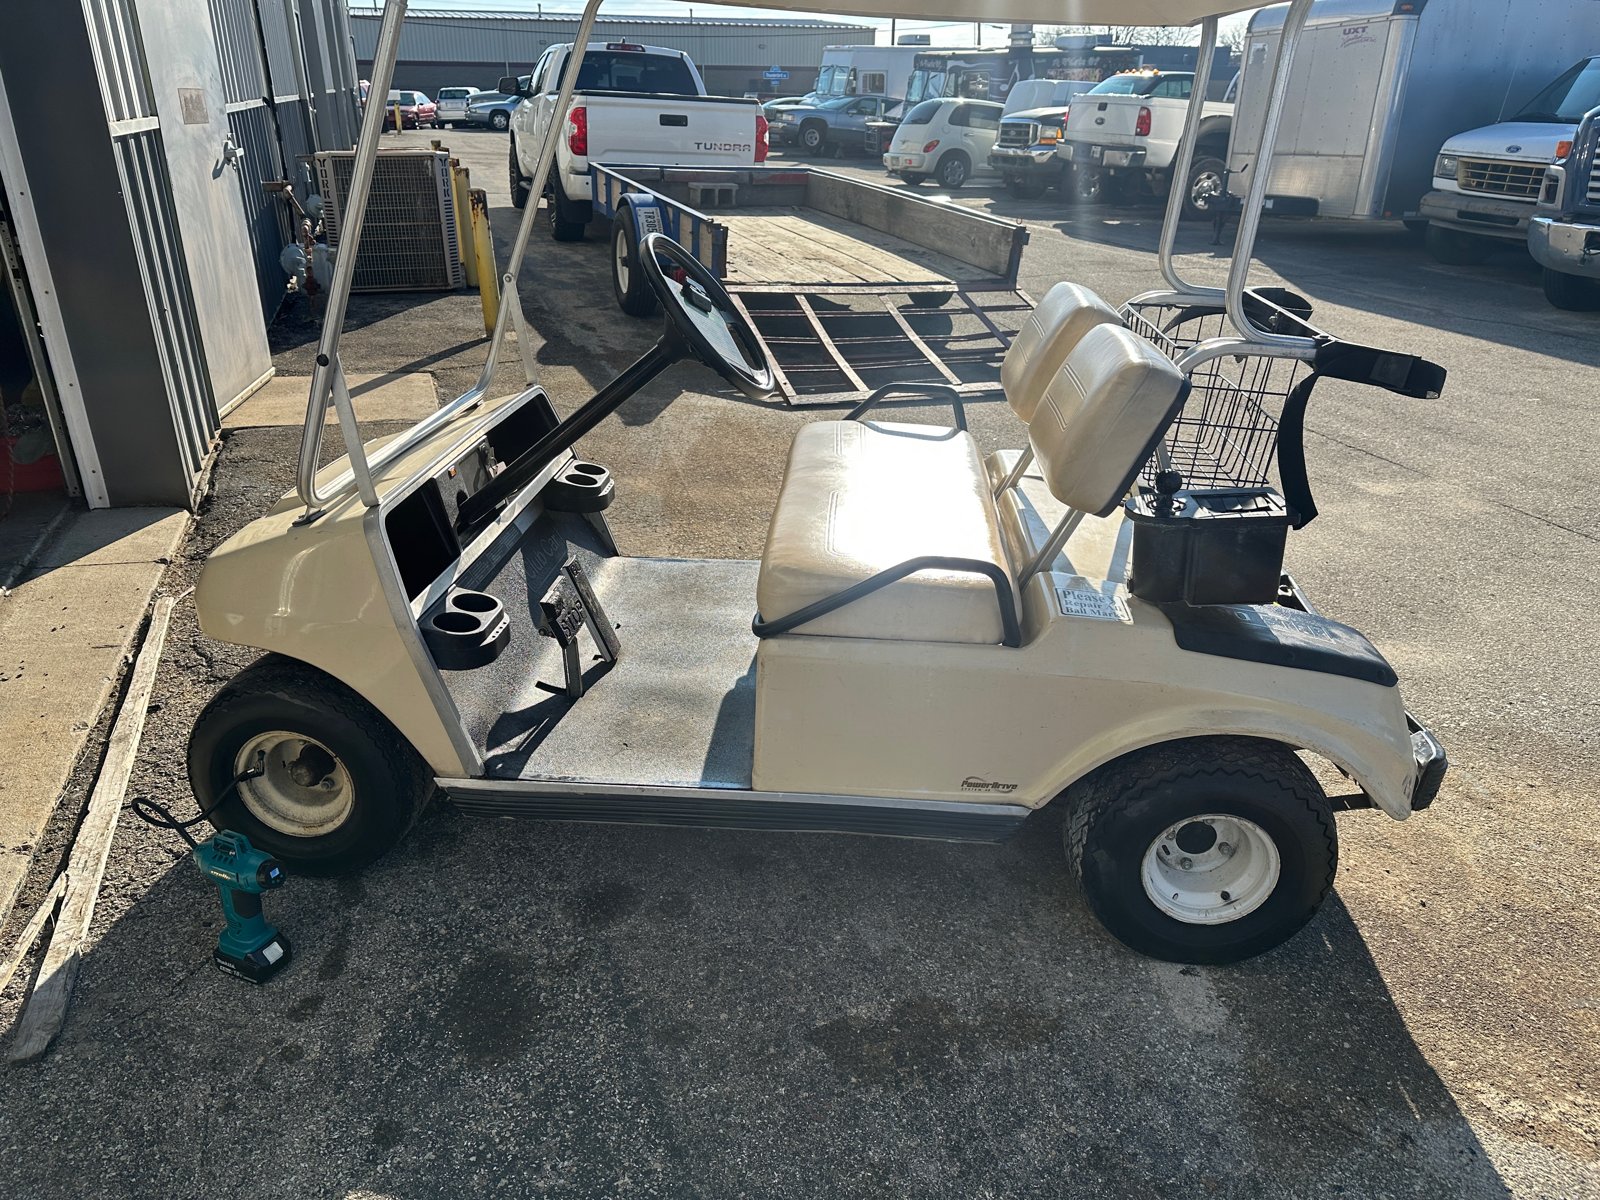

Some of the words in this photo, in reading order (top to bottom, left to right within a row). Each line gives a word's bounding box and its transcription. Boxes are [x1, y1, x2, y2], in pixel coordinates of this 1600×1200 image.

[1343, 26, 1368, 35] UXT
[694, 141, 751, 151] TUNDRA
[316, 158, 331, 199] YORK
[438, 158, 450, 198] YORK
[1062, 590, 1105, 602] Please
[1064, 599, 1104, 610] Repair
[1065, 606, 1088, 615] Ball
[560, 600, 584, 638] STOP
[961, 780, 1018, 789] PowerDrive
